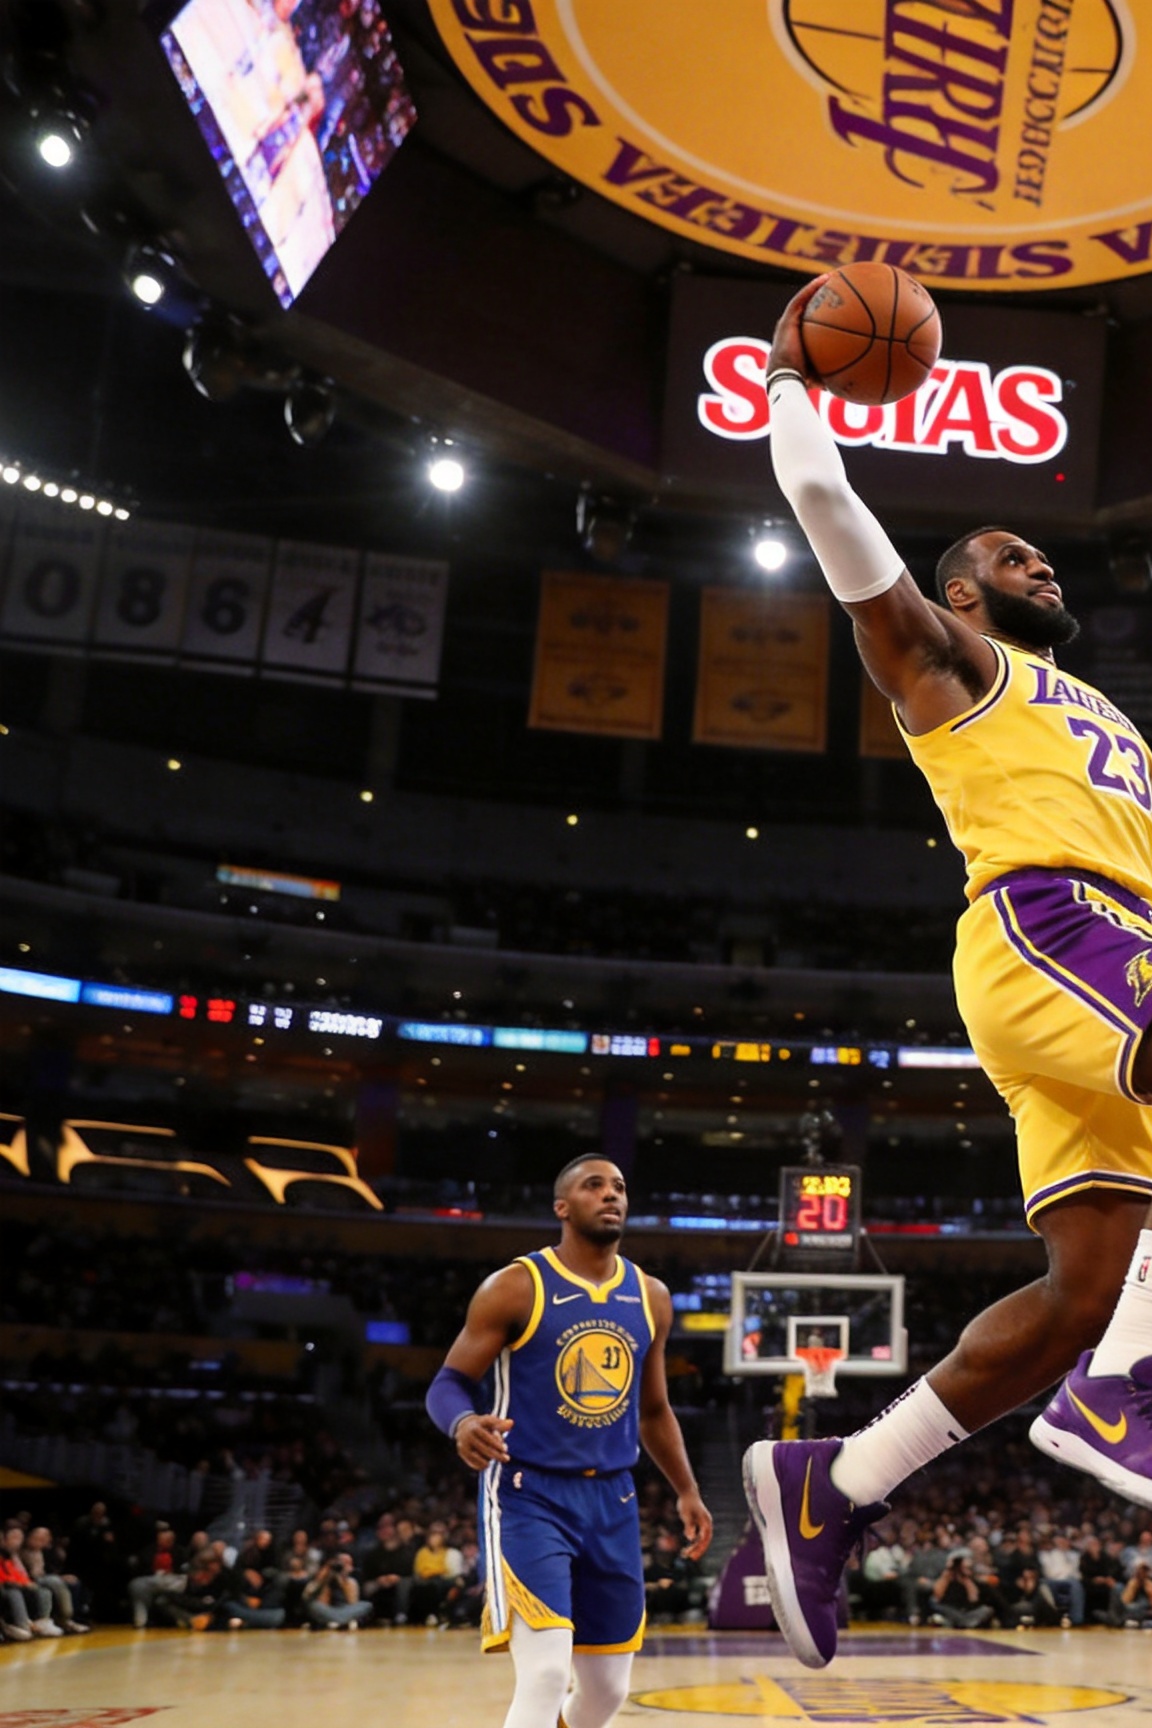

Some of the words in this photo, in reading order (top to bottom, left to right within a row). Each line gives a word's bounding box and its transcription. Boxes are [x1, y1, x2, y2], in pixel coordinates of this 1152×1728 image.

[117, 566, 166, 627] 8
[202, 576, 250, 635] 6
[1065, 714, 1152, 811] 23
[797, 1194, 848, 1230] 20
